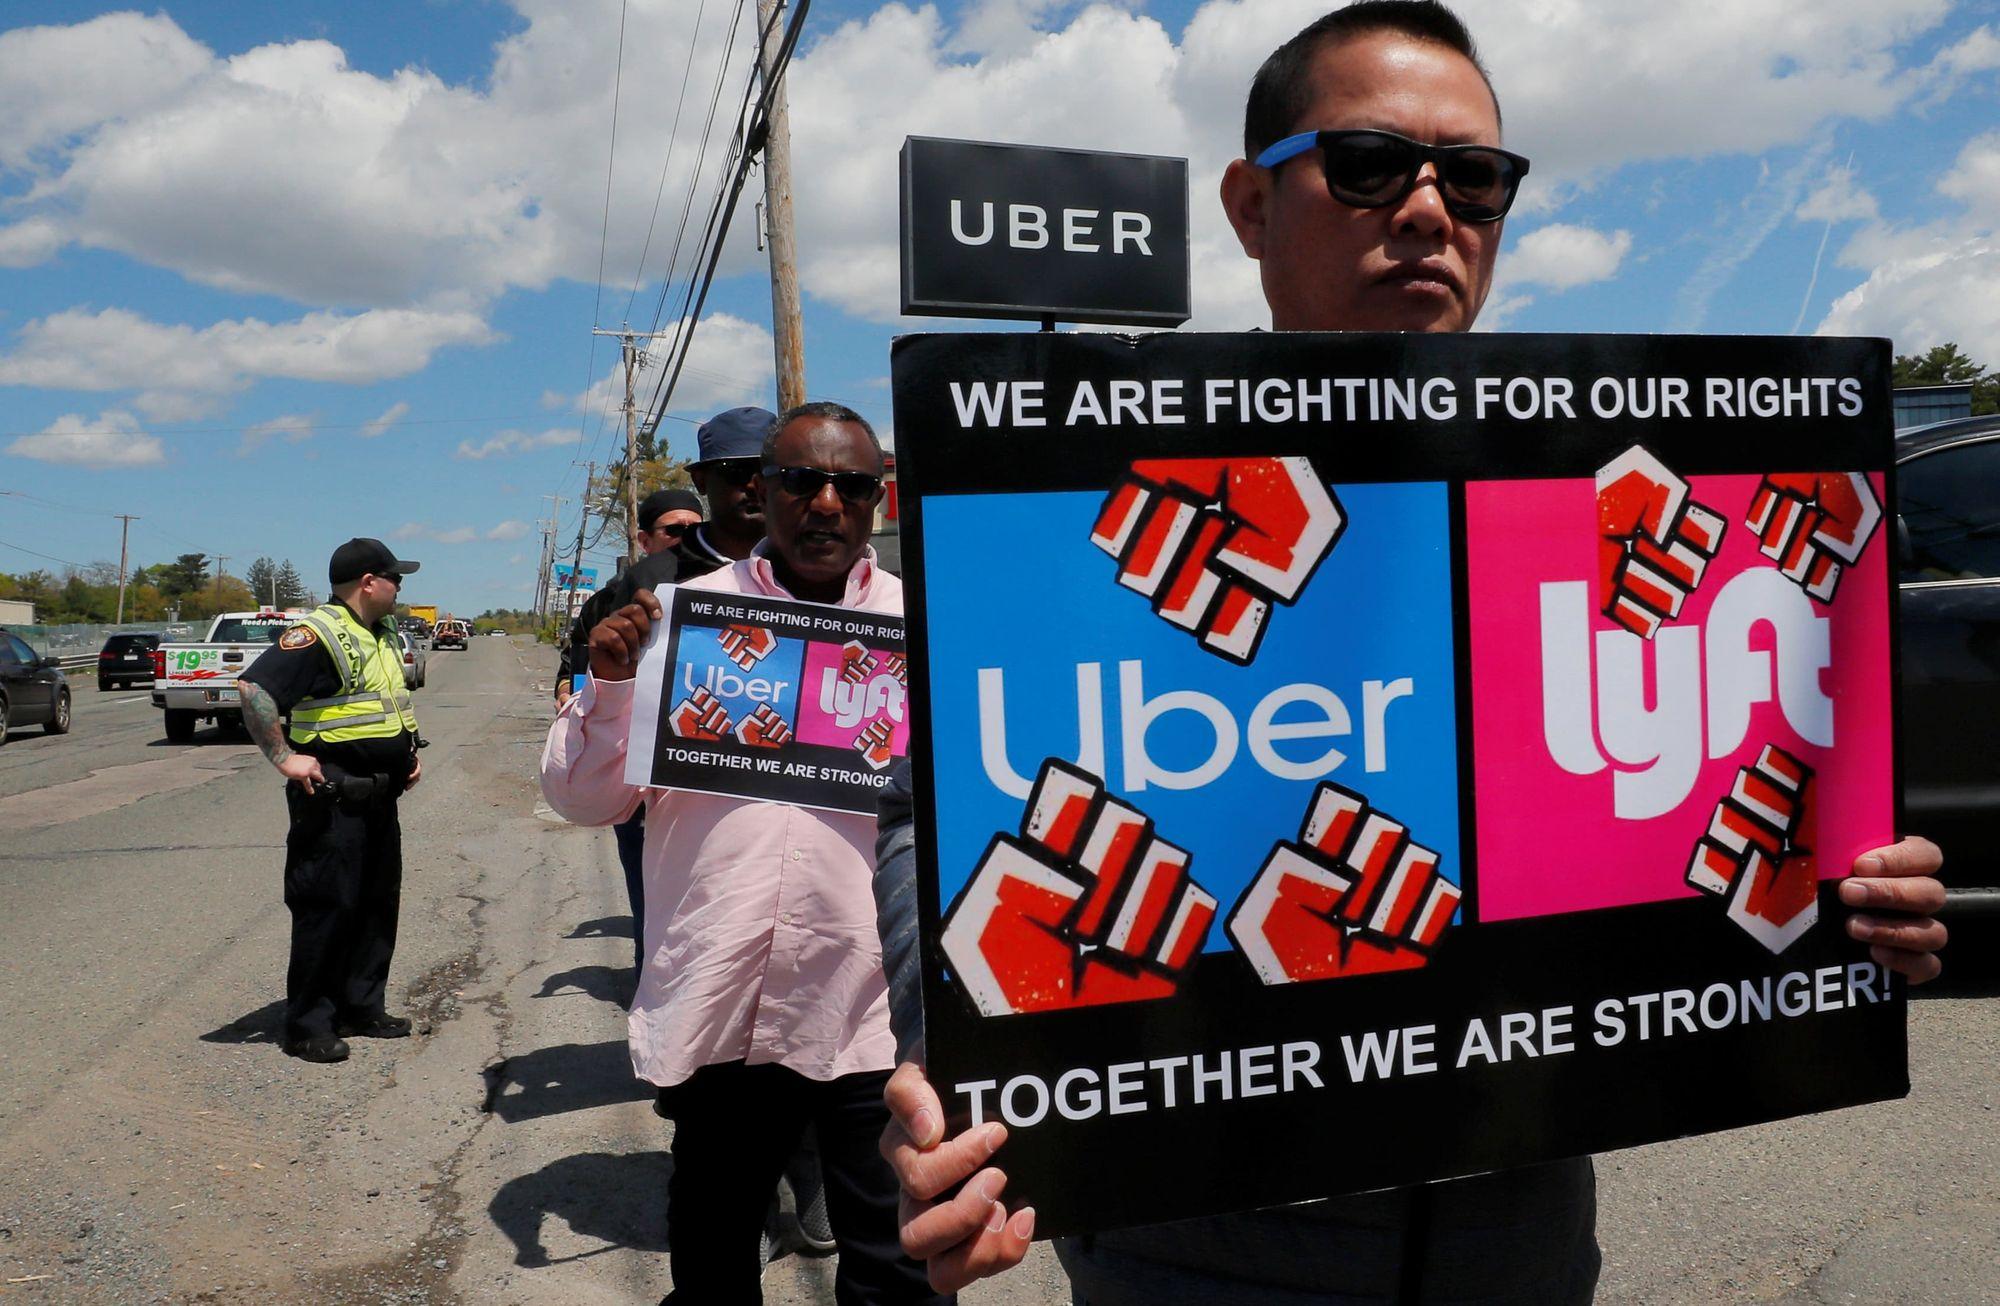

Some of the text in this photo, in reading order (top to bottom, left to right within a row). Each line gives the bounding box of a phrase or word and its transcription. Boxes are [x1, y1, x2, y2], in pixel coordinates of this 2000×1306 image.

[950, 199, 1153, 256] UBER
[950, 376, 1864, 428] WE ARE FIGHTING FOR OUR RIGHTS
[690, 602, 713, 615] WE
[715, 605, 745, 619] ARE
[747, 609, 811, 628] FIGHTING
[813, 617, 842, 632] FOR
[845, 622, 874, 636] OUR
[684, 662, 788, 703] Uber
[820, 667, 906, 728] lyft
[1539, 565, 1834, 820] lyft
[978, 660, 1413, 801] Uber
[666, 748, 752, 770] TOGETHER
[756, 758, 781, 774] WE
[783, 762, 817, 779] ARE
[955, 962, 1892, 1128] TOGETHER WE ARE STRONGER!
